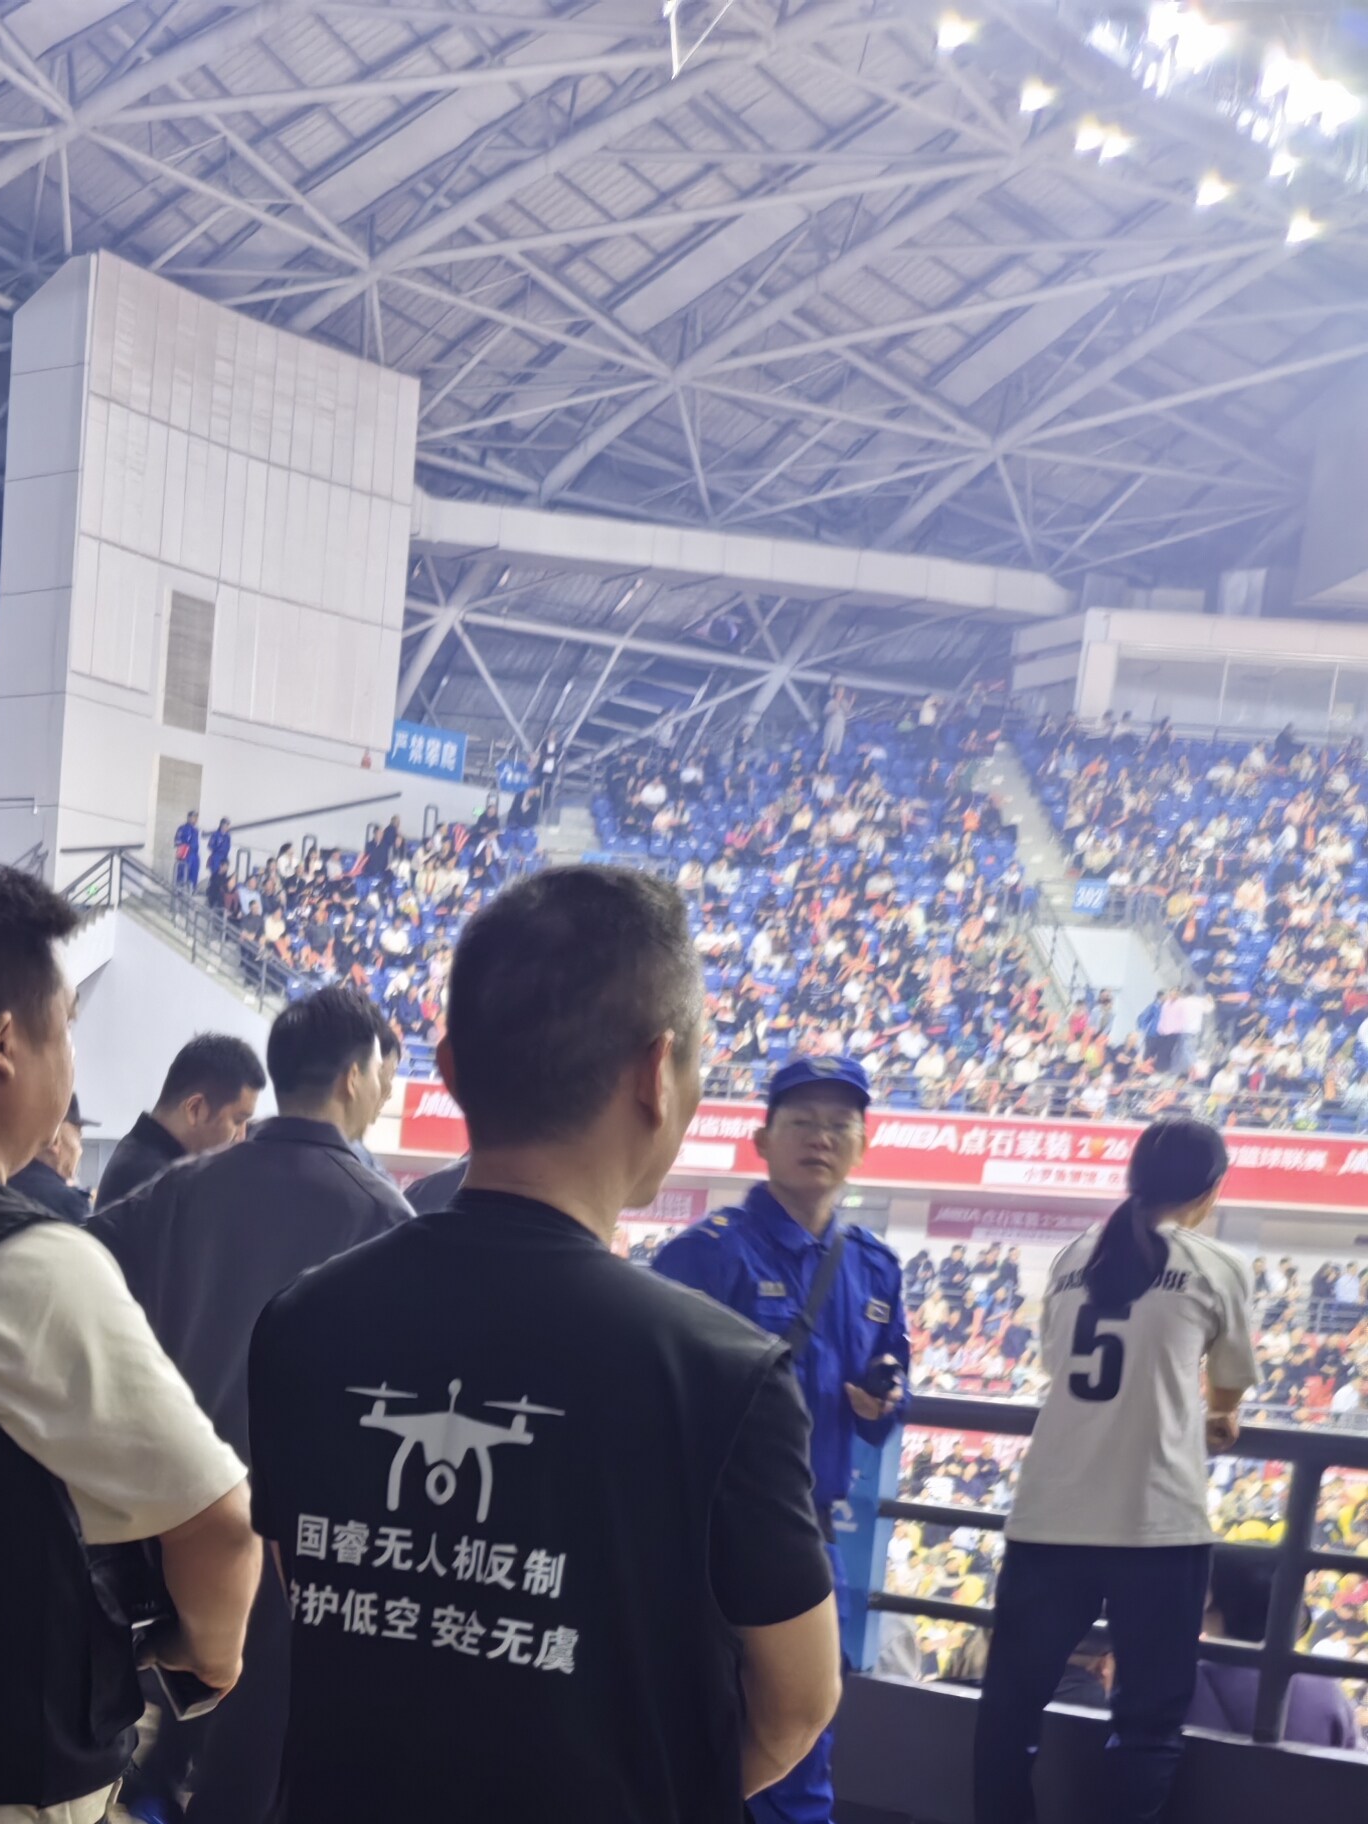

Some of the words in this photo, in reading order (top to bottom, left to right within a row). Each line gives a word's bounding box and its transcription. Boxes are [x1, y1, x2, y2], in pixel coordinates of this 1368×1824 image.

[390, 730, 459, 772] 严禁攀爬
[1068, 1301, 1132, 1404] 5
[296, 1512, 567, 1599] 国睿无人机反制
